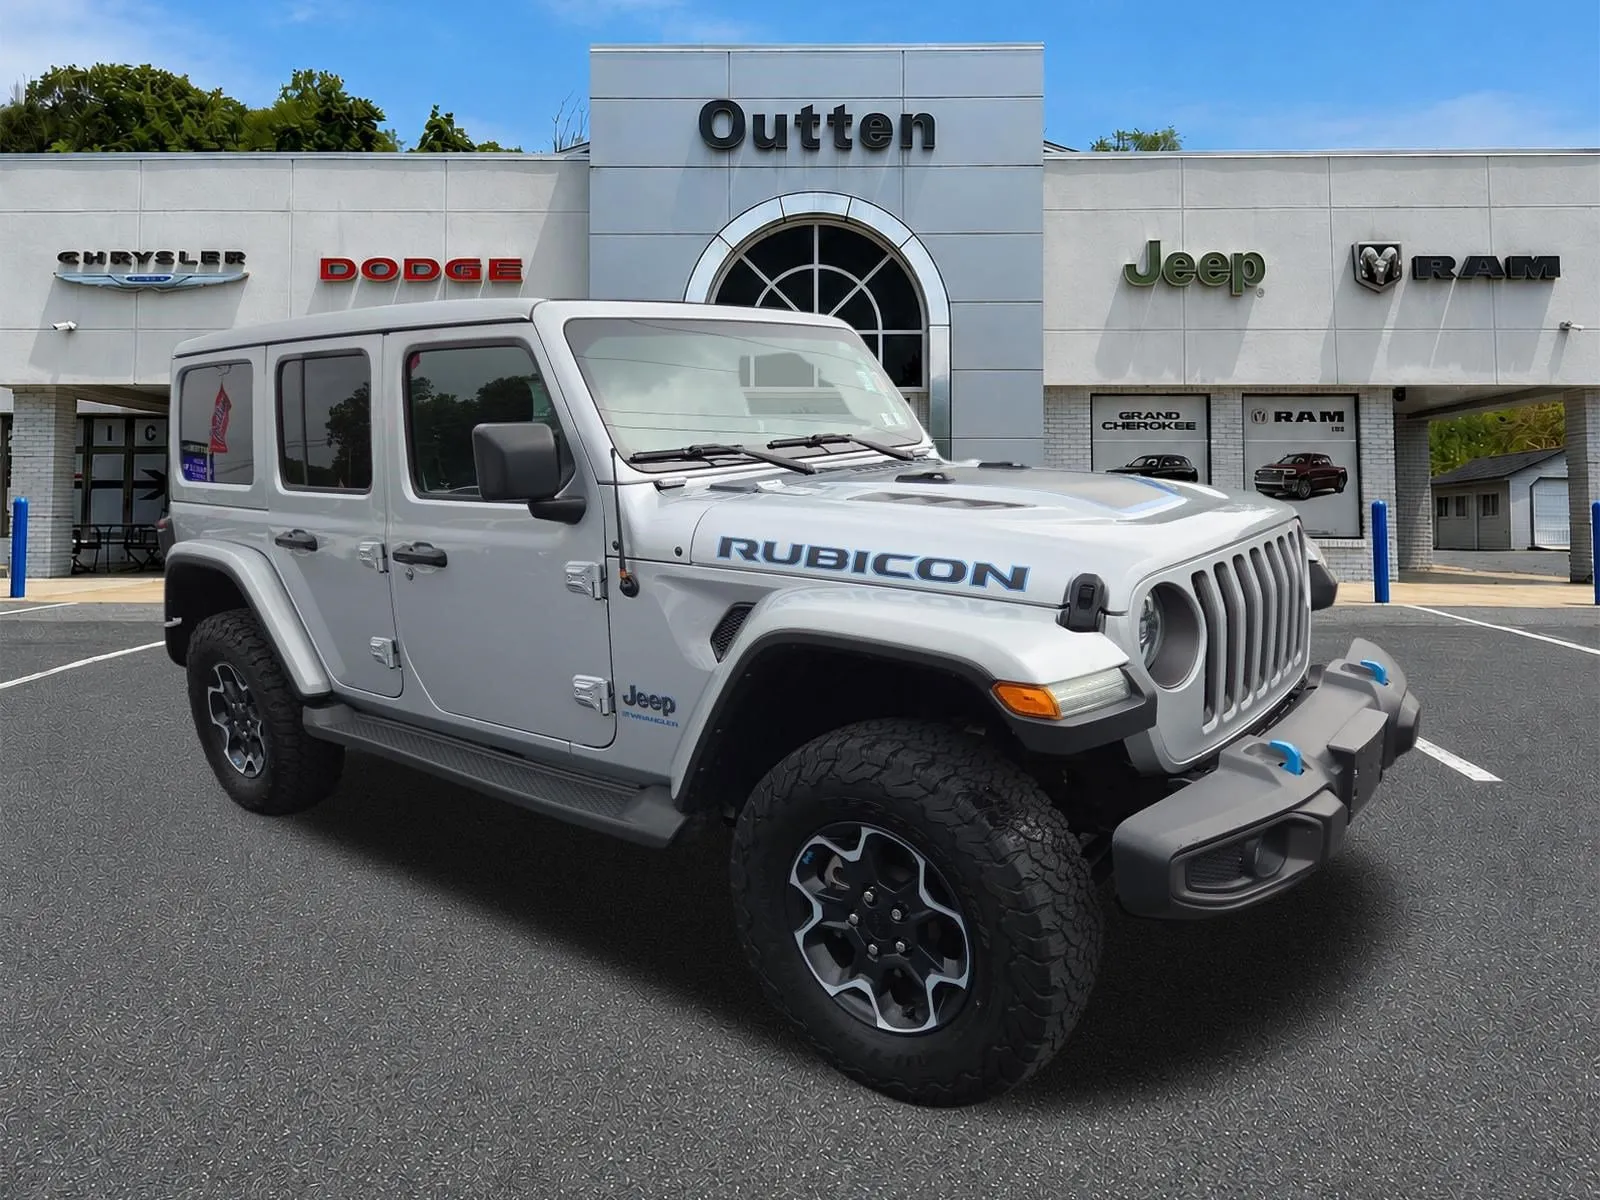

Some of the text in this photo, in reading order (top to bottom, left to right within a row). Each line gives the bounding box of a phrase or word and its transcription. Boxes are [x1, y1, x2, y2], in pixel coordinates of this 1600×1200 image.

[698, 99, 936, 149] Outten
[57, 251, 247, 265] CHRYSLER
[320, 257, 523, 282] DODGE
[1123, 240, 1266, 297] Jeep
[1412, 255, 1561, 280] RAM
[1101, 421, 1197, 431] CHEROKEE
[1118, 411, 1181, 421] GRAND
[1274, 411, 1344, 422] RAM
[717, 535, 1031, 593] RUBICON
[622, 684, 677, 716] Jeep
